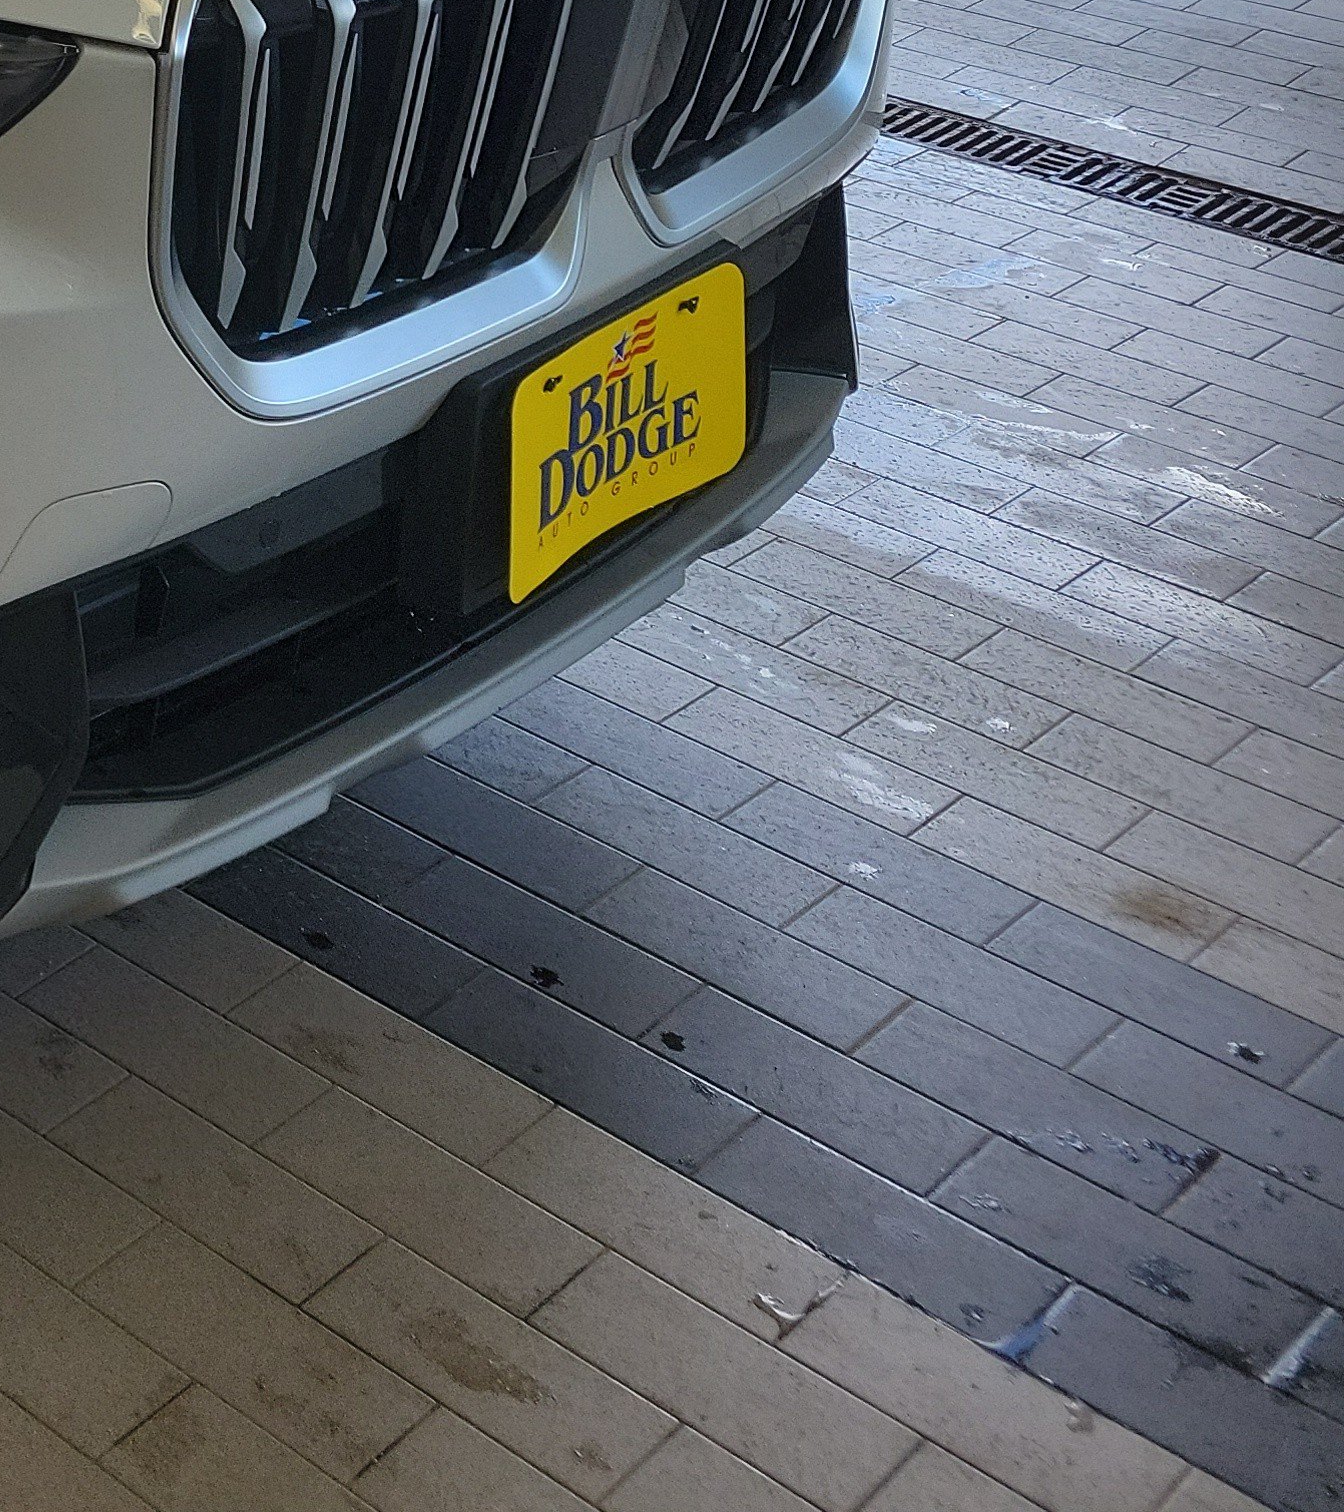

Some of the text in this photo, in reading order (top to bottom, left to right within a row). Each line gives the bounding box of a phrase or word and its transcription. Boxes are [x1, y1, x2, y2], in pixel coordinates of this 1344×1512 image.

[568, 359, 669, 452] BILL
[537, 390, 702, 536] DODGE
[537, 443, 696, 551] AUTO GROUP
